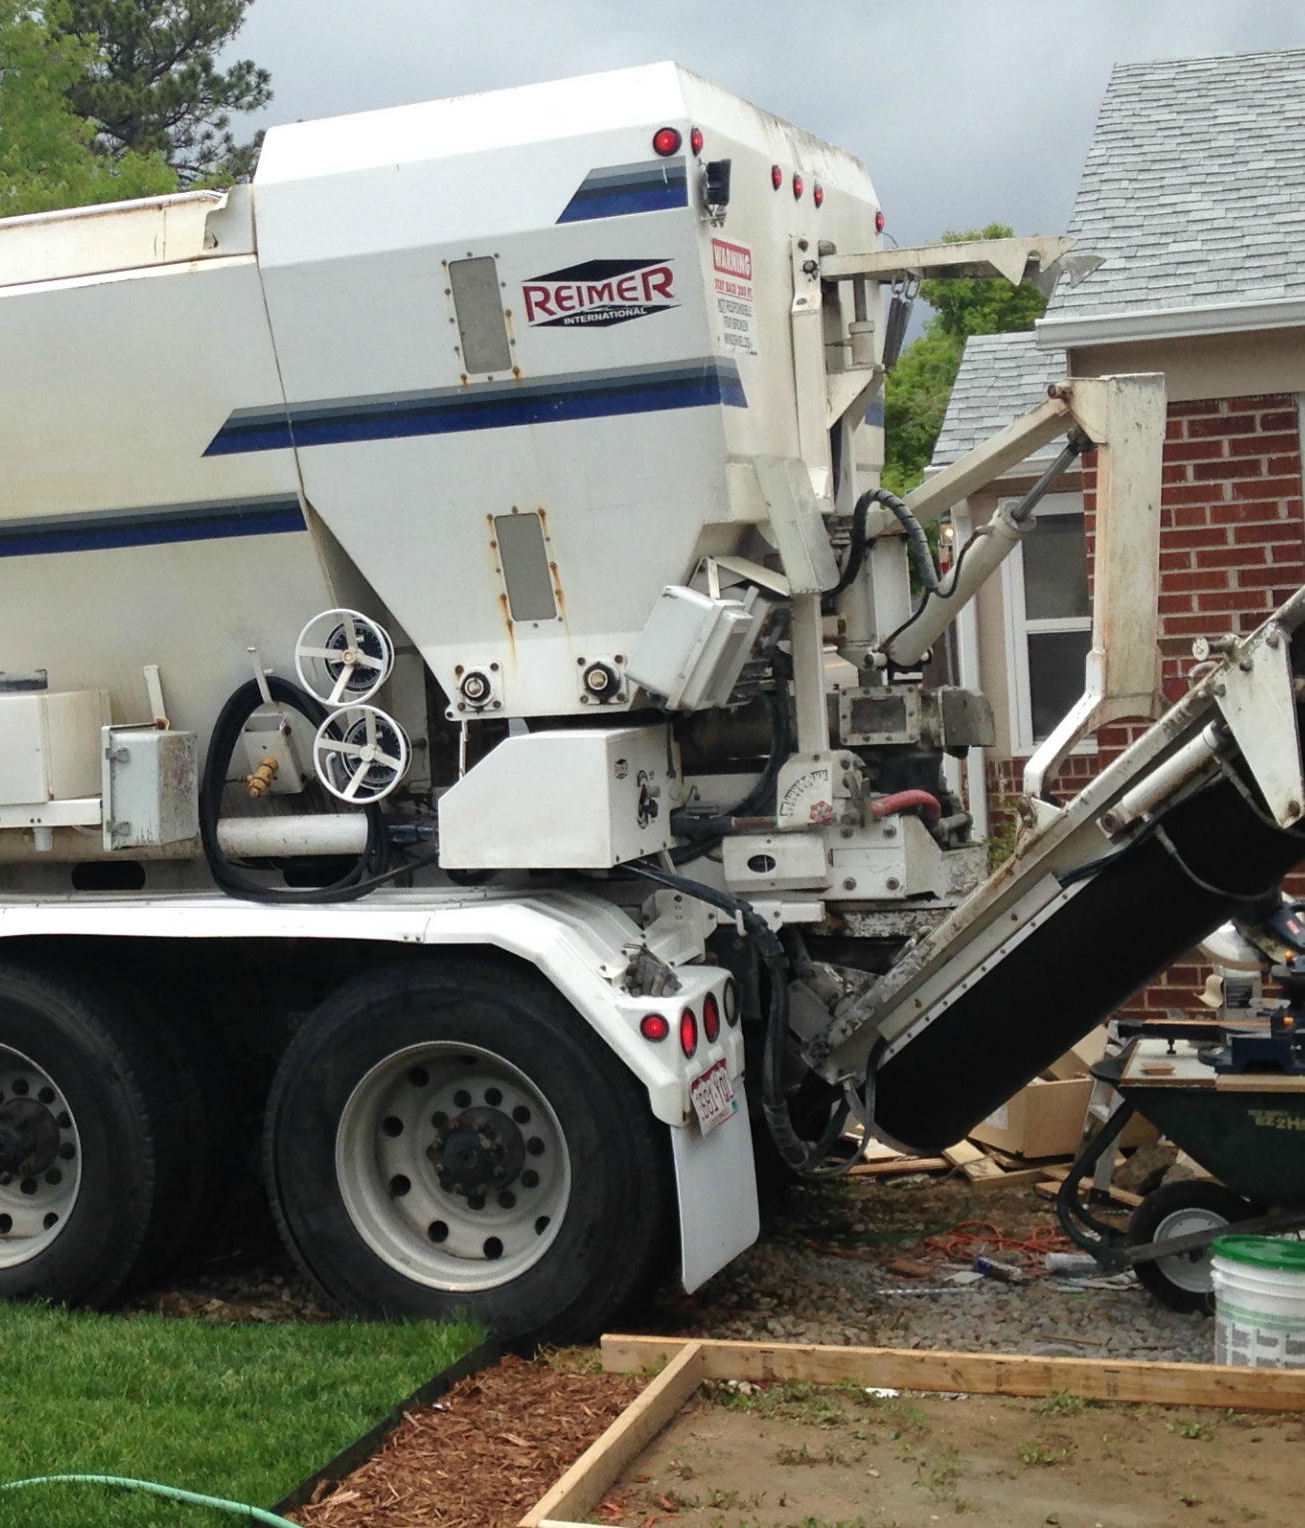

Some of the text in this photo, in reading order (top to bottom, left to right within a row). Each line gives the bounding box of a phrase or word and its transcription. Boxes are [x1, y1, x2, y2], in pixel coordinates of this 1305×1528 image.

[714, 245, 751, 276] WARNING
[522, 266, 675, 323] REIMER
[715, 278, 725, 291] STAY
[726, 281, 736, 295] BACK
[564, 307, 648, 326] INTERNATIONAL
